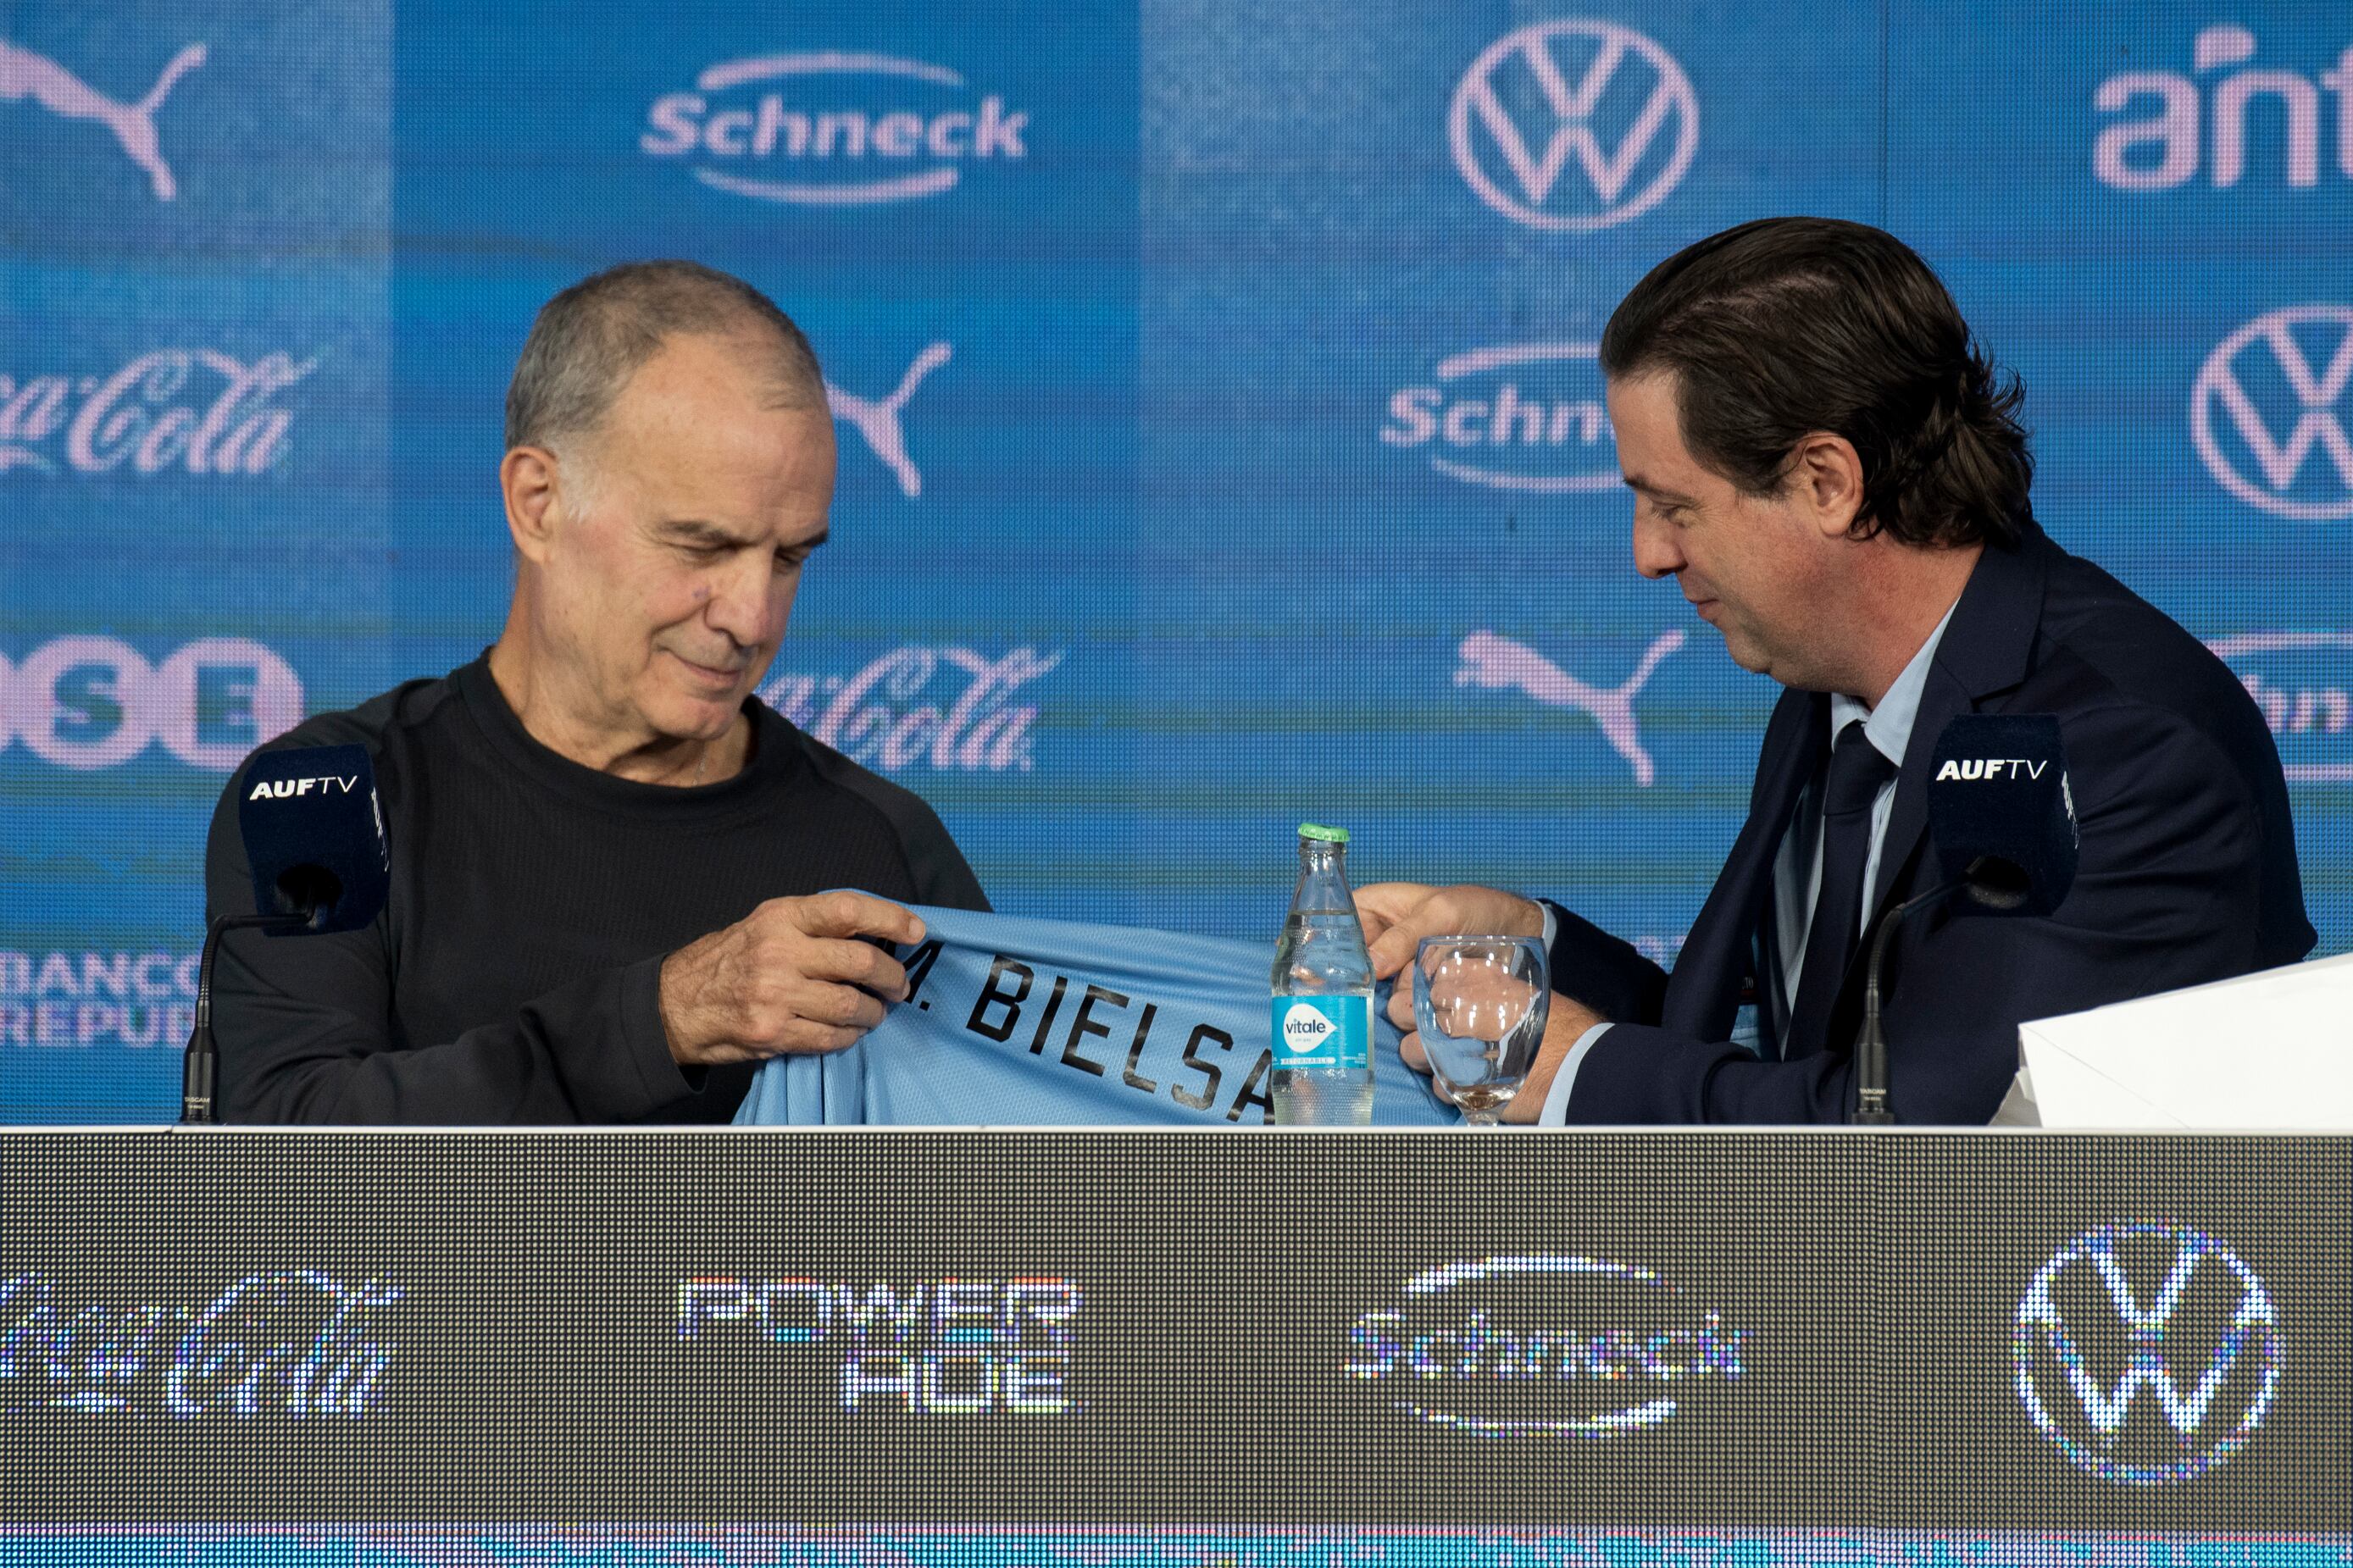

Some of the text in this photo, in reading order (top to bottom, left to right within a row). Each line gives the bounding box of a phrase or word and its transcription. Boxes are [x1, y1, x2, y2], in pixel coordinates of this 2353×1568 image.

[641, 91, 1029, 159] Schneck
[1379, 384, 1617, 446] Schn
[249, 775, 358, 801] AUFTV
[1936, 759, 2048, 781] AUFTV
[1285, 1018, 1327, 1034] vitale
[1340, 1306, 1756, 1379] Schneck
